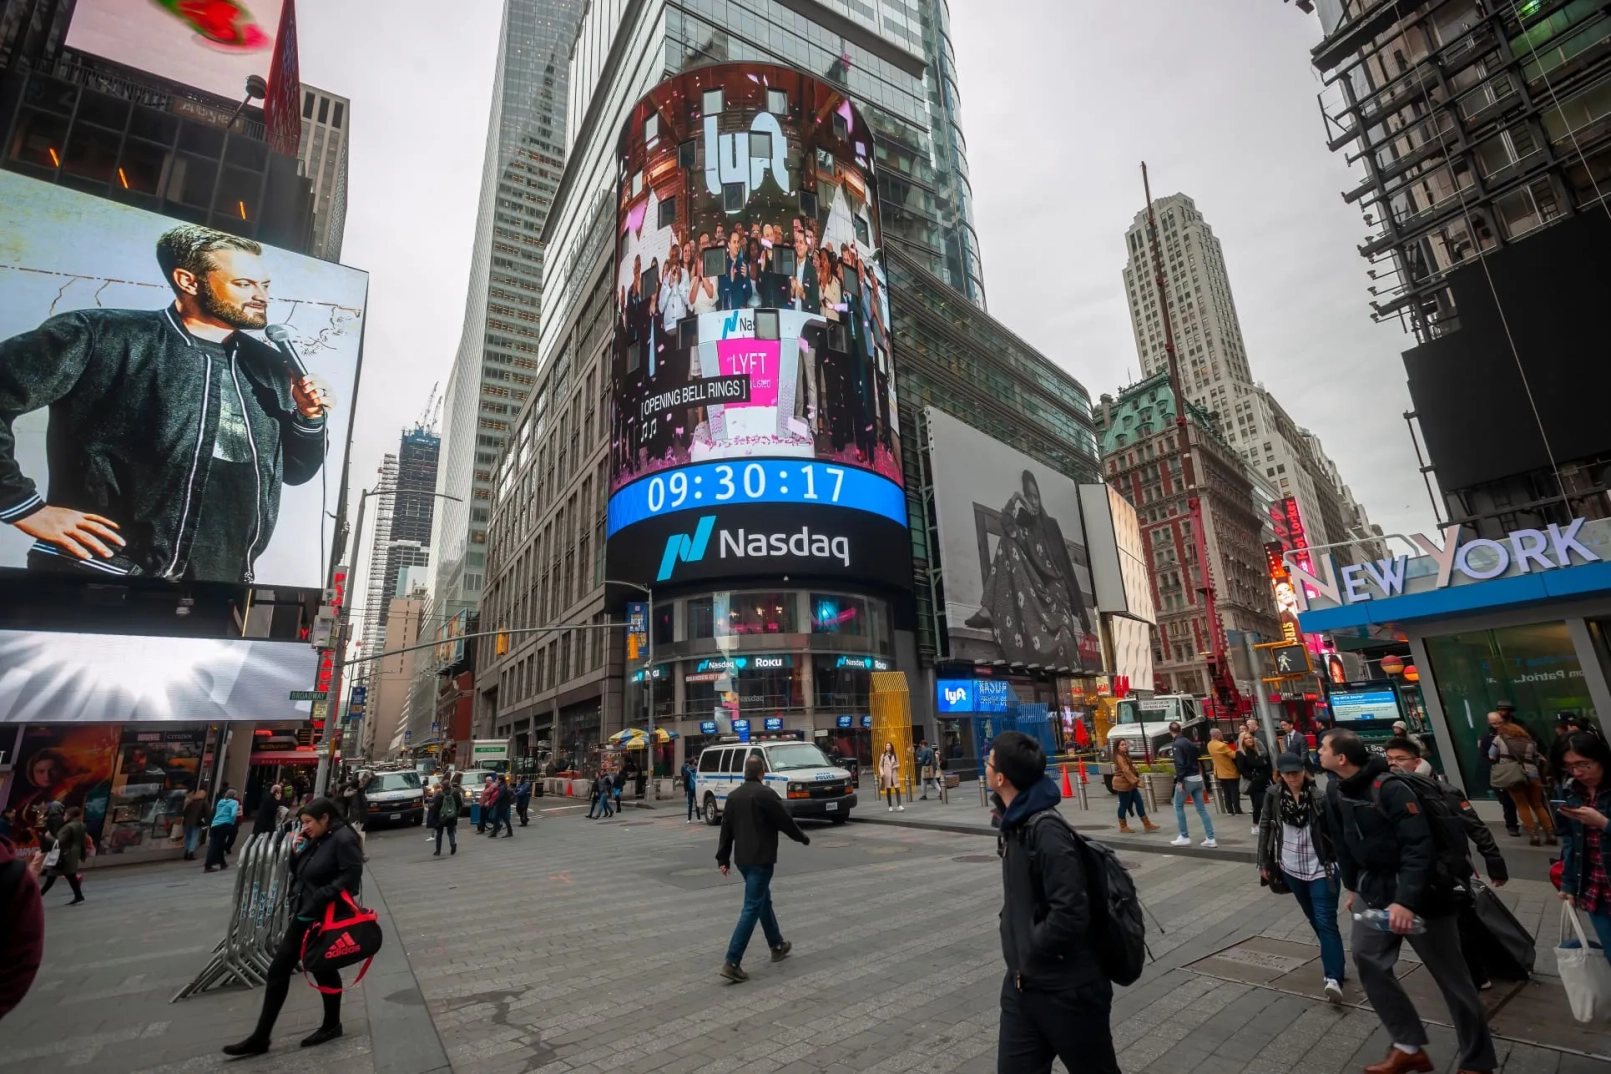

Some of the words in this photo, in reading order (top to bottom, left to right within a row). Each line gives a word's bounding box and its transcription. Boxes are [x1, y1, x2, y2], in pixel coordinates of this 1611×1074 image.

[732, 353, 767, 375] LYFT
[682, 386, 706, 403] BELL
[707, 380, 740, 399] RINGS
[719, 526, 850, 567] Nasdaq
[708, 660, 735, 669] Nasdaq
[845, 659, 865, 668] Nasdaq
[291, 692, 326, 700] BROADWAY
[324, 944, 361, 959] adidas
